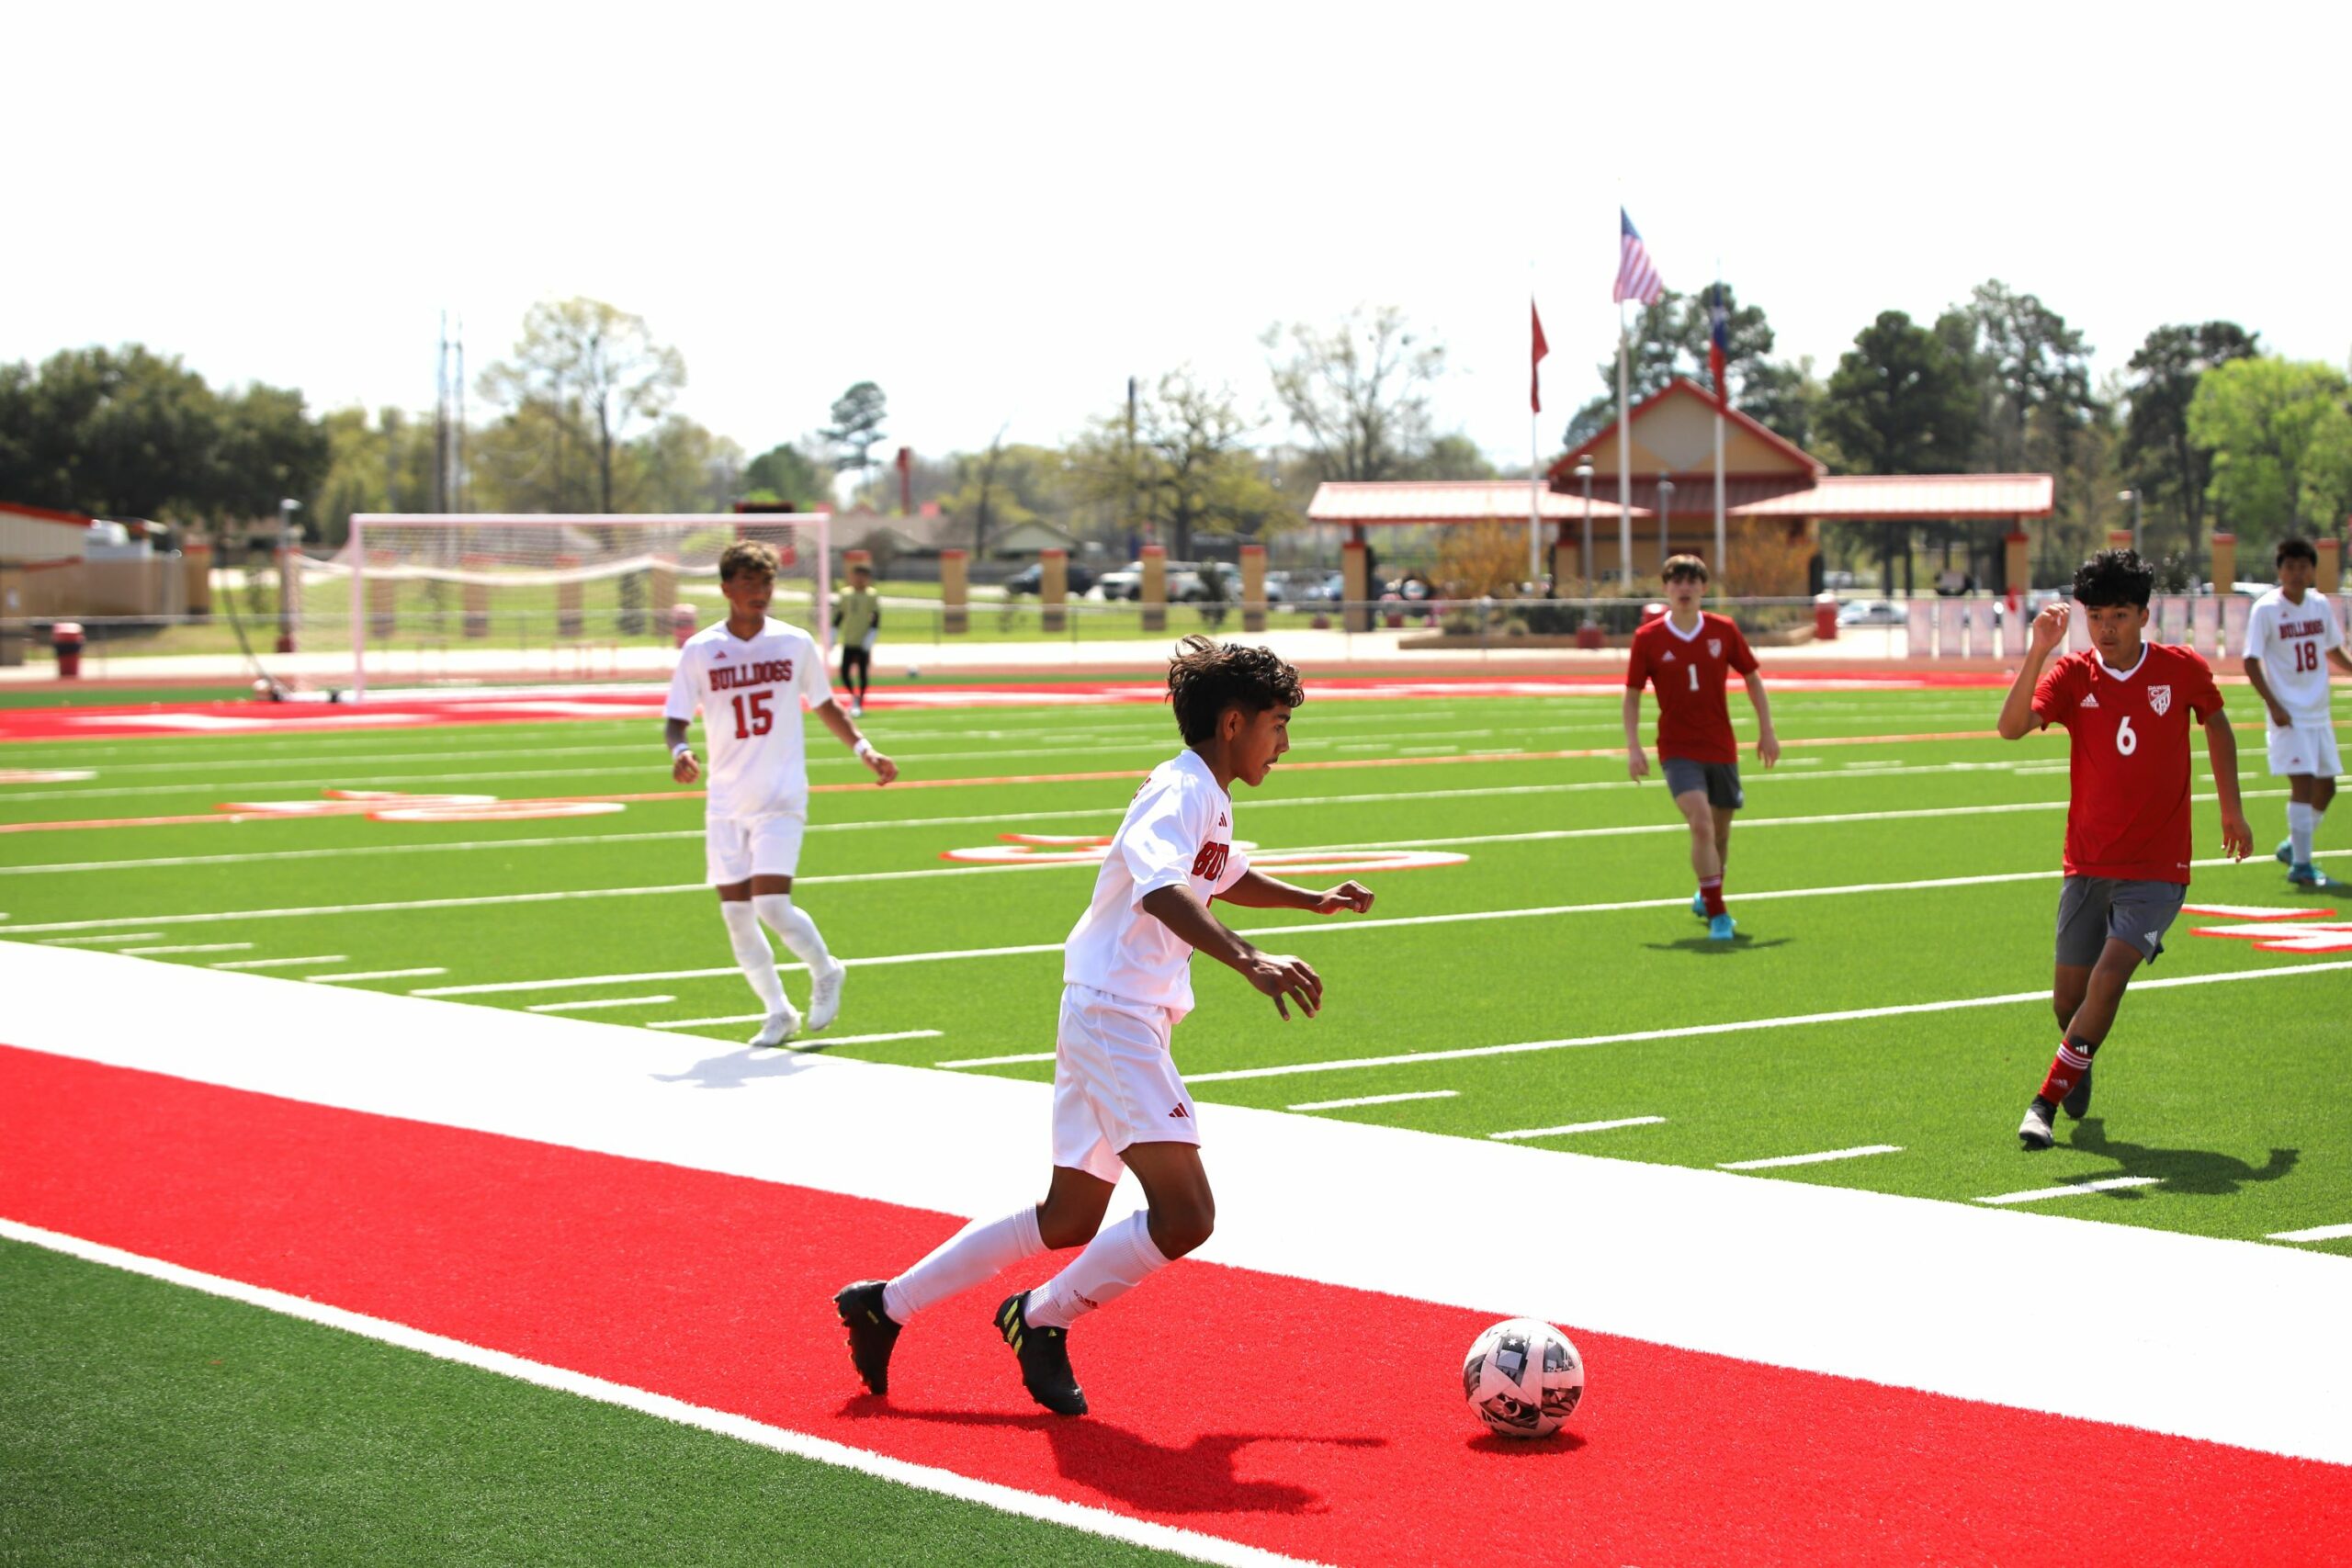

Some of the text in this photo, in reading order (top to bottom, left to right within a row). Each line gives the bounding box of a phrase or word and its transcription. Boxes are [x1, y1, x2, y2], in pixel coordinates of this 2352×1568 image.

[2279, 619, 2324, 639] BULLDOGS
[2295, 640, 2318, 672] 18
[708, 659, 793, 692] BULLDOGS
[1688, 663, 1700, 692] 1
[731, 690, 774, 739] 15
[2116, 716, 2137, 756] 6
